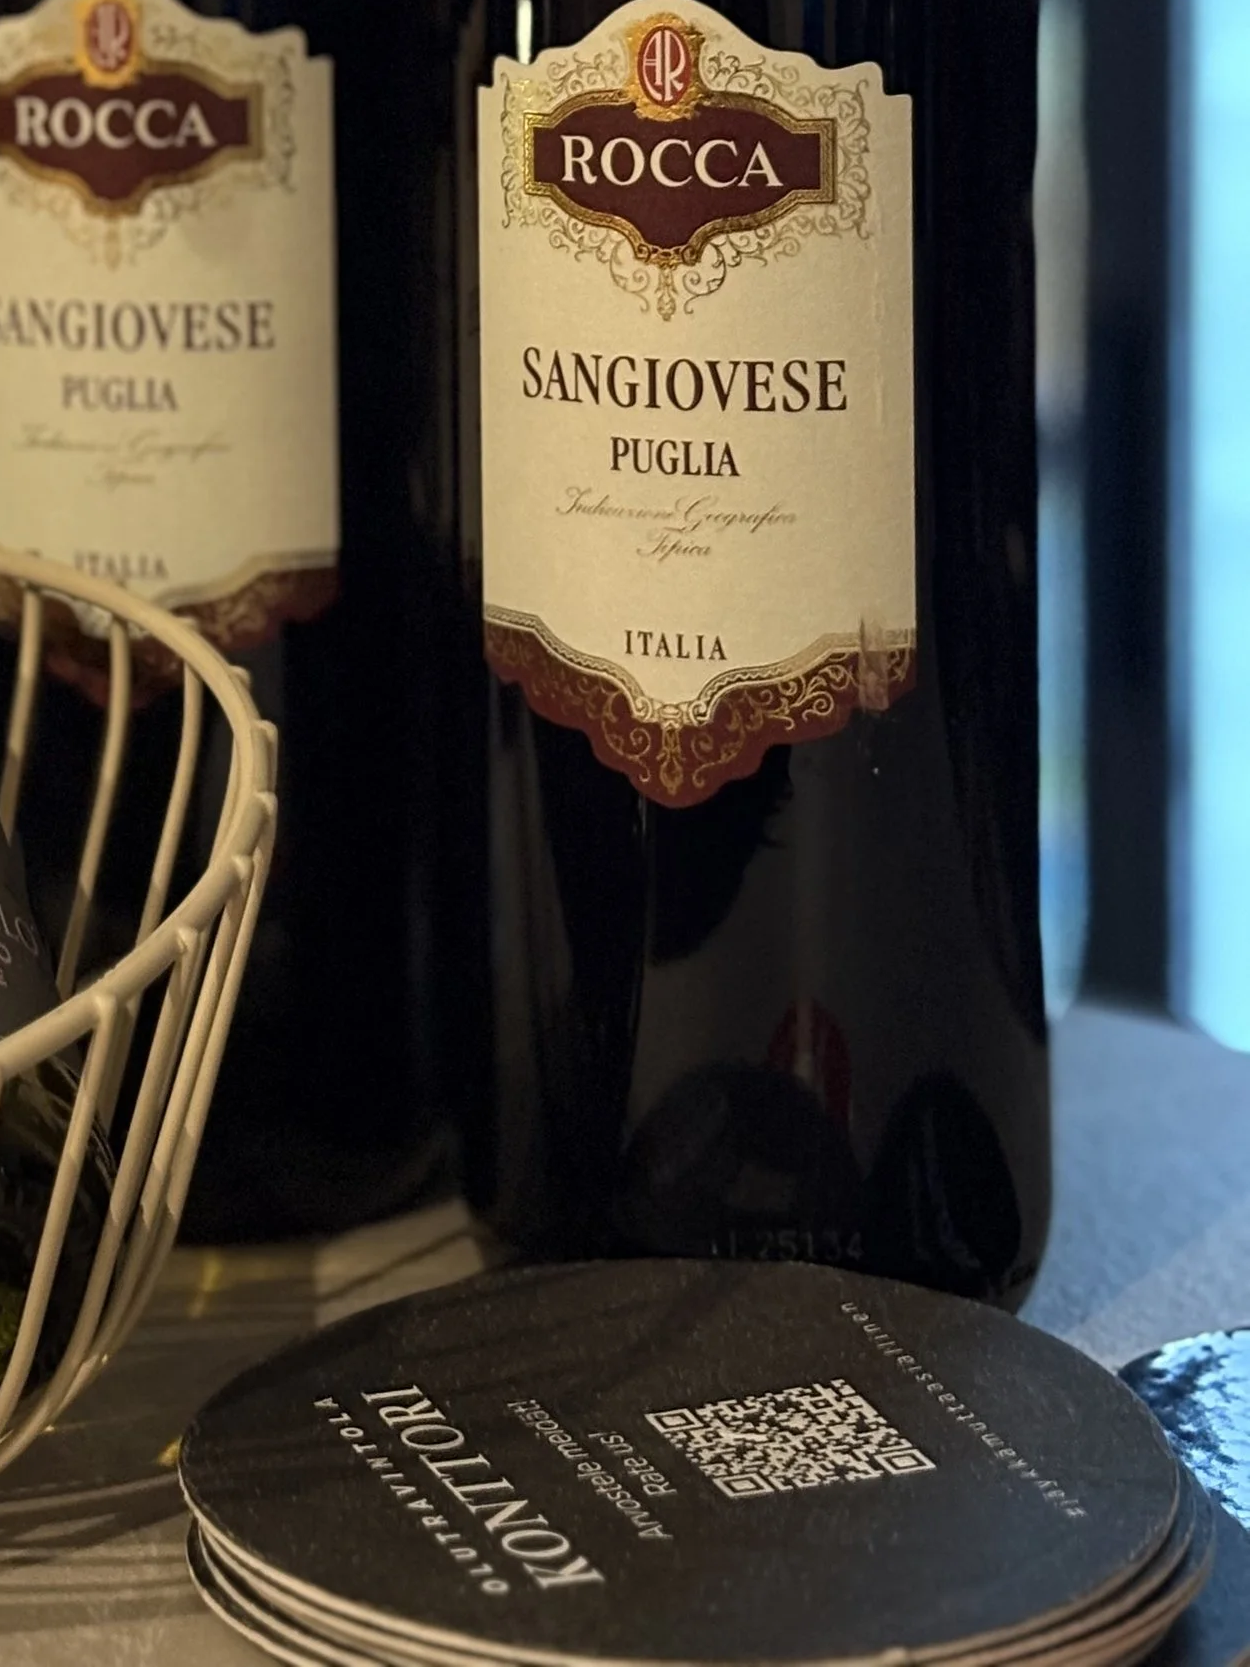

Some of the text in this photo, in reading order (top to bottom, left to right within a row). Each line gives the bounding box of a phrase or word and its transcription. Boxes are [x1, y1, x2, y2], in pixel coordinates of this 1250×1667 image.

[14, 96, 217, 148] ROCCA
[560, 135, 784, 189] ROCCA
[62, 375, 178, 413] PUGLIA
[522, 346, 848, 413] SANGIOVESE
[609, 436, 740, 477] PUGLIA
[72, 550, 168, 579] ITALIA
[624, 628, 728, 661] ITALIA
[360, 1384, 606, 1589] KONTTORI
[588, 1431, 678, 1497] Rate us!
[313, 1396, 511, 1595] OLUTRAVINTOLA
[577, 1461, 674, 1540] Arvostele
